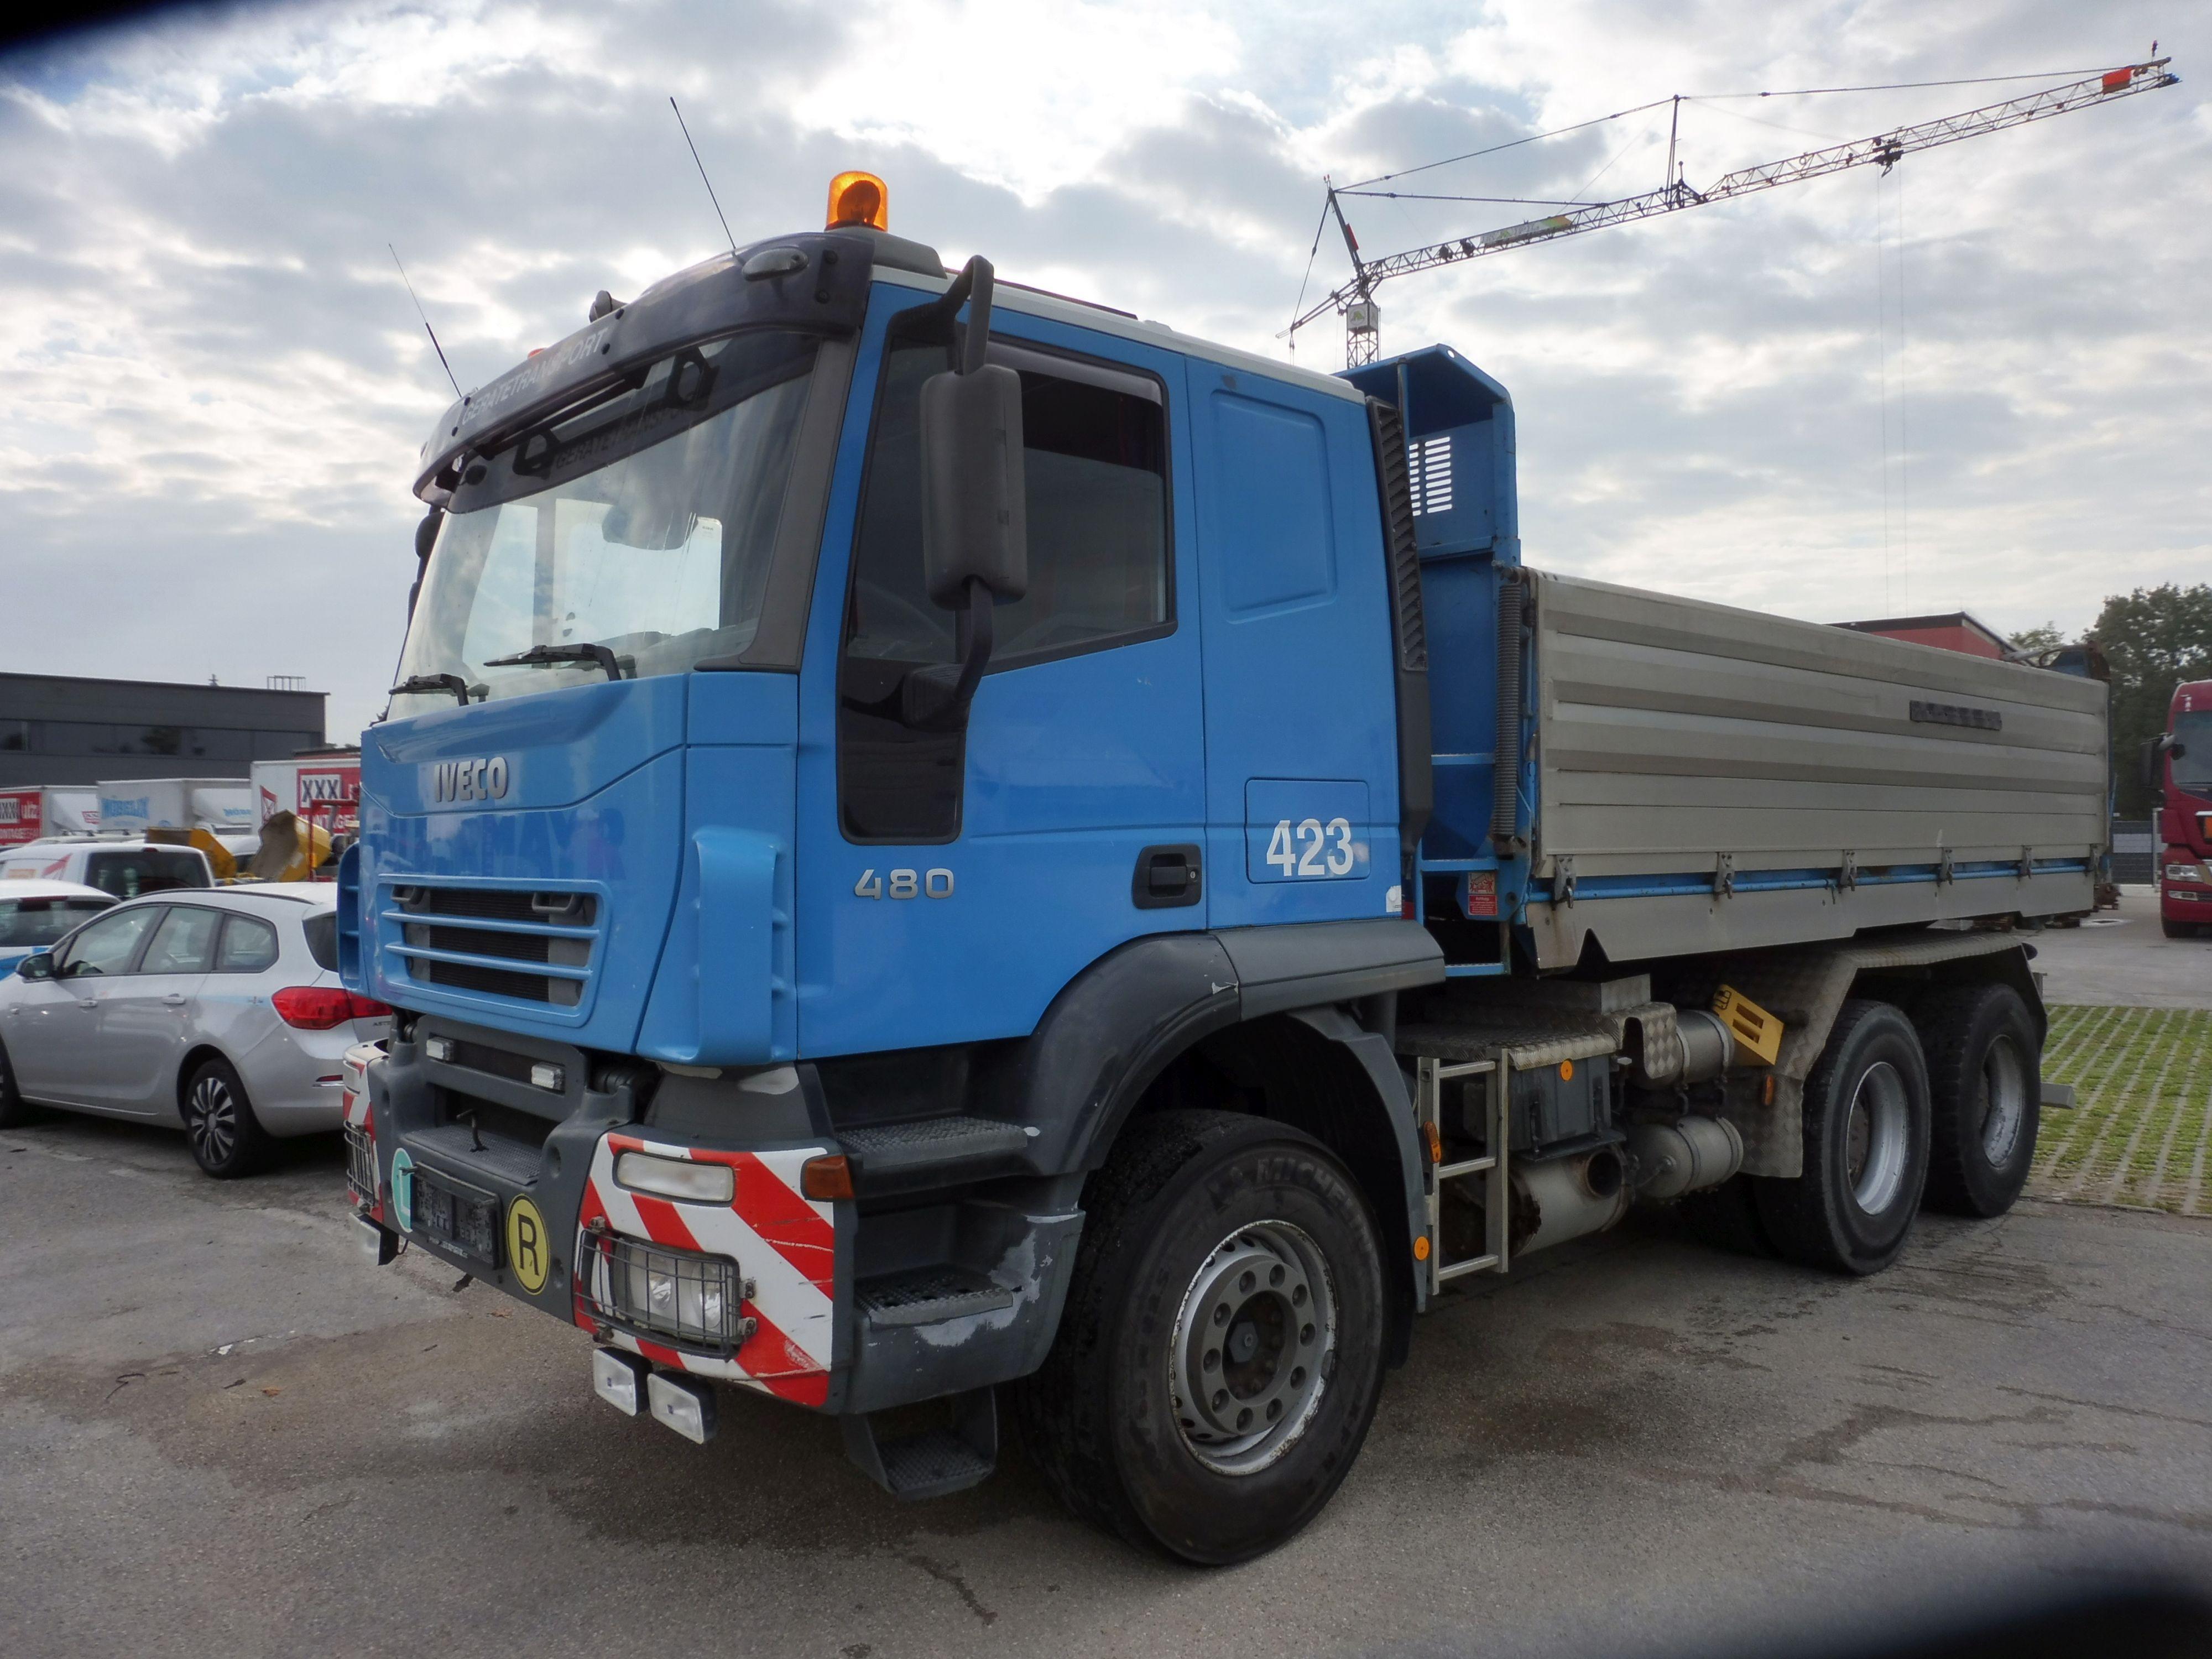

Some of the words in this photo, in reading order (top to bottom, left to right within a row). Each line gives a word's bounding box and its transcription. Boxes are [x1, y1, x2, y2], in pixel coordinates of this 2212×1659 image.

[434, 757, 508, 802] IVECO
[1266, 817, 1353, 877] 423
[854, 868, 954, 900] 480
[518, 1213, 539, 1276] R
